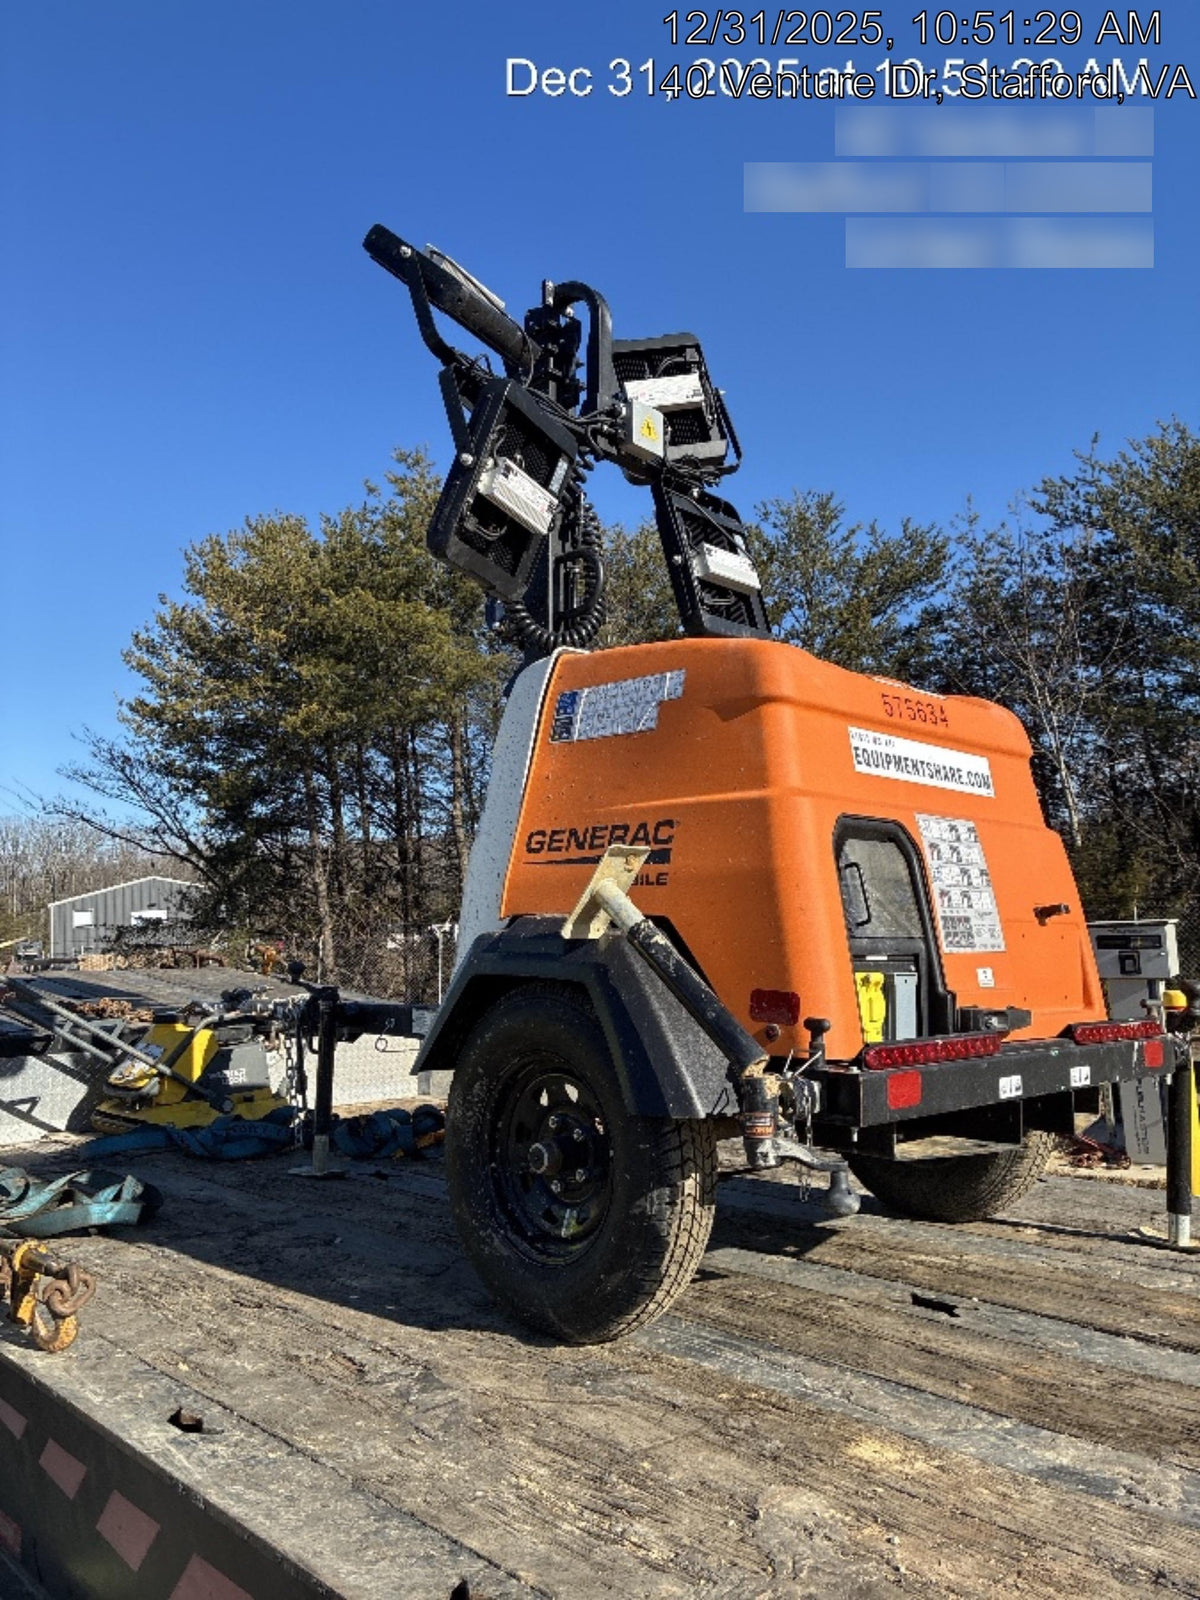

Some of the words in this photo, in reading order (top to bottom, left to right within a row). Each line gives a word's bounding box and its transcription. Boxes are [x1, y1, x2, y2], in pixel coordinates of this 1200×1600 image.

[881, 692, 949, 728] 575634
[852, 745, 991, 790] EQUIPMENTSHARE.COM
[525, 819, 675, 855] GENERAC
